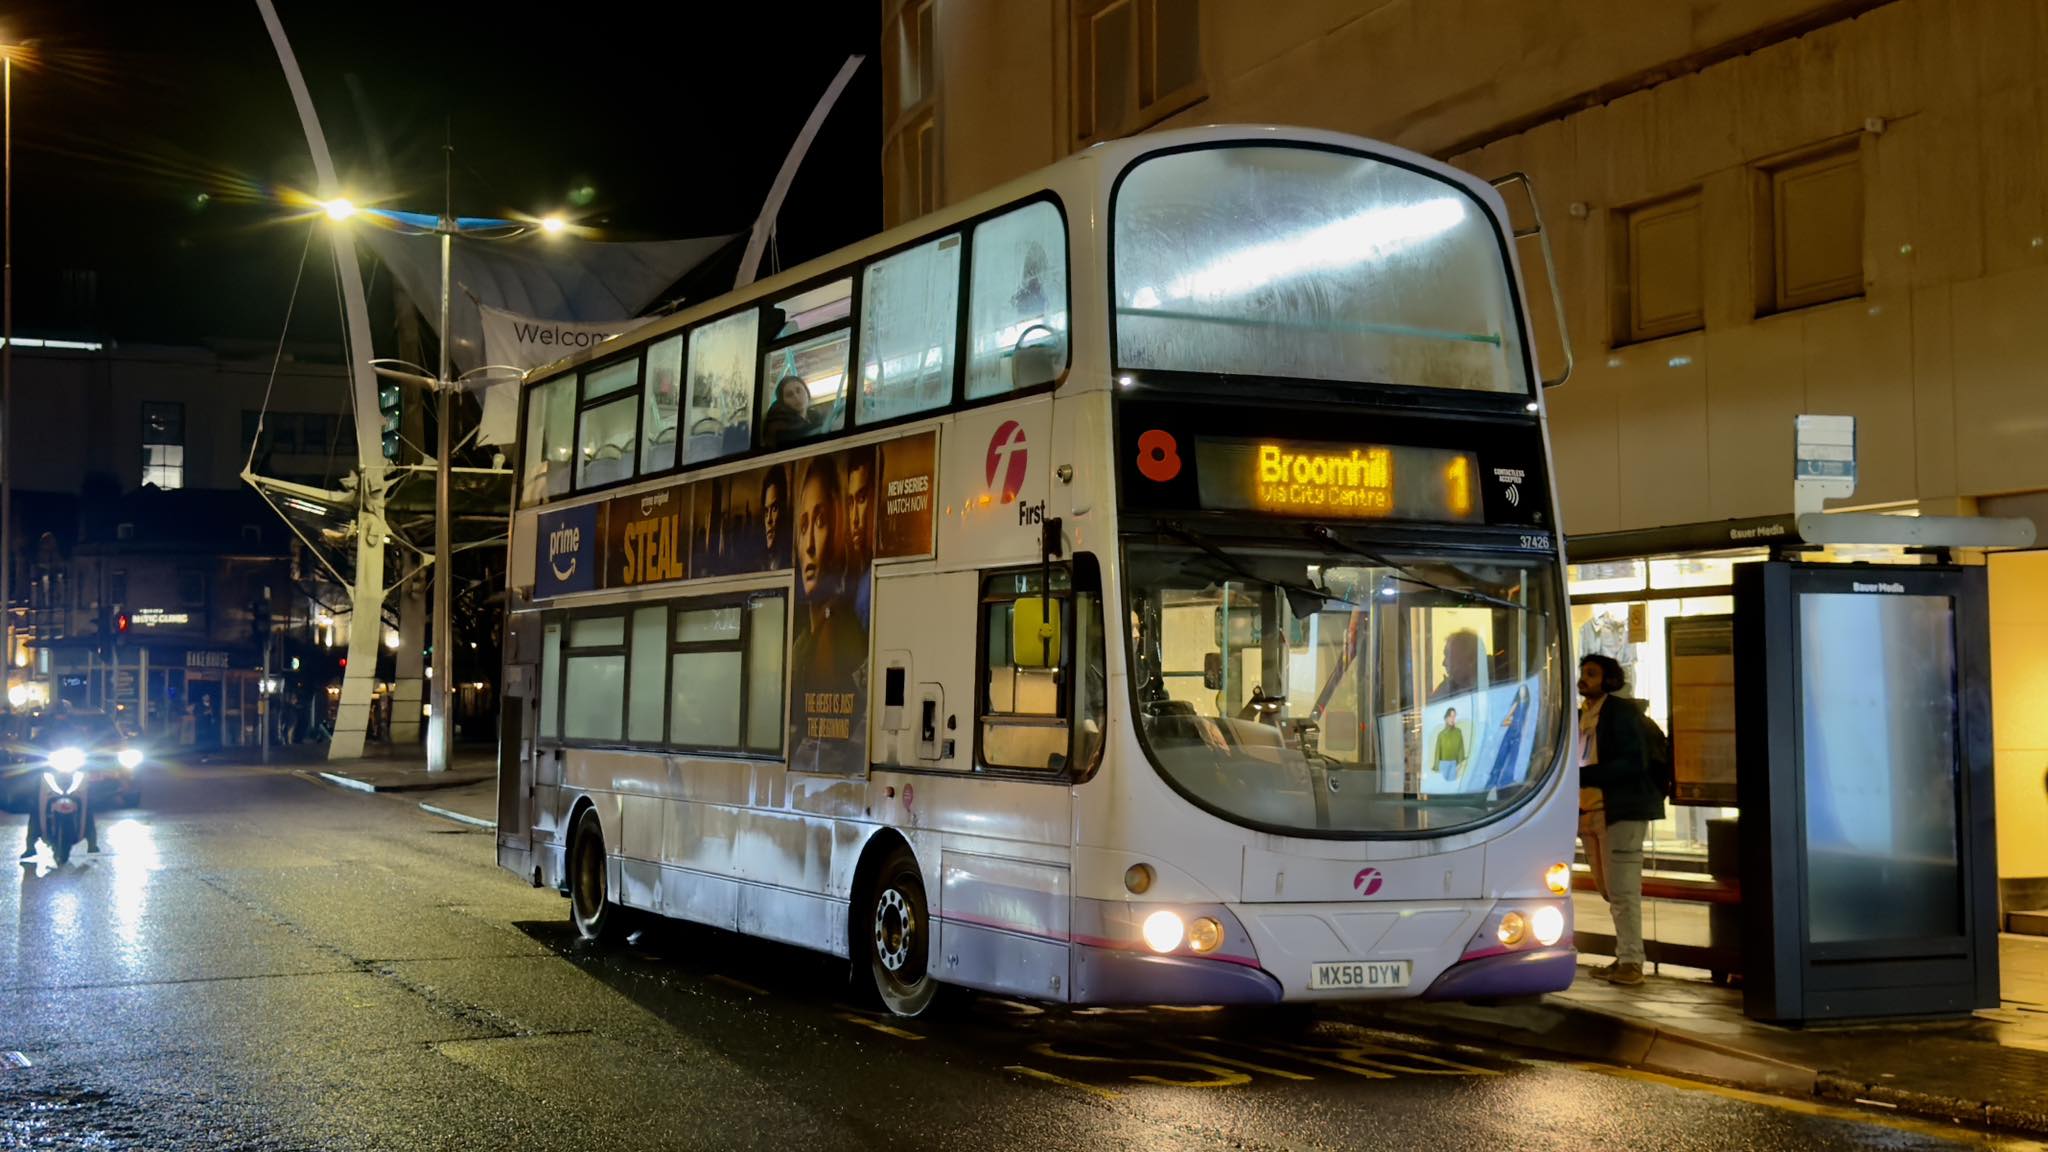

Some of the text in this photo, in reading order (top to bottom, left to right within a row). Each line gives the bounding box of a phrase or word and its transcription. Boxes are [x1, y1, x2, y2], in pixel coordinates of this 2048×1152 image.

[1260, 445, 1389, 488] Broomhill
[1493, 467, 1525, 477] CONTACTLESS
[888, 475, 928, 497] NEW SERIES
[1448, 456, 1469, 511] 1
[1499, 475, 1522, 484] ACCEPTED
[887, 494, 928, 515] WATCH NOW
[1290, 484, 1324, 505] City
[1328, 486, 1385, 507] Centre
[1019, 500, 1045, 526] First
[550, 522, 580, 562] prime
[1520, 535, 1550, 549] 37426
[1730, 524, 1785, 540] Bauer Media
[623, 514, 683, 585] STEAL
[1852, 581, 1905, 593] Bauer Media
[804, 693, 816, 713] THE
[816, 693, 833, 713] HEIST
[833, 693, 840, 713] IS
[807, 717, 818, 737] THE
[1319, 965, 1401, 985] MX58 DYW
